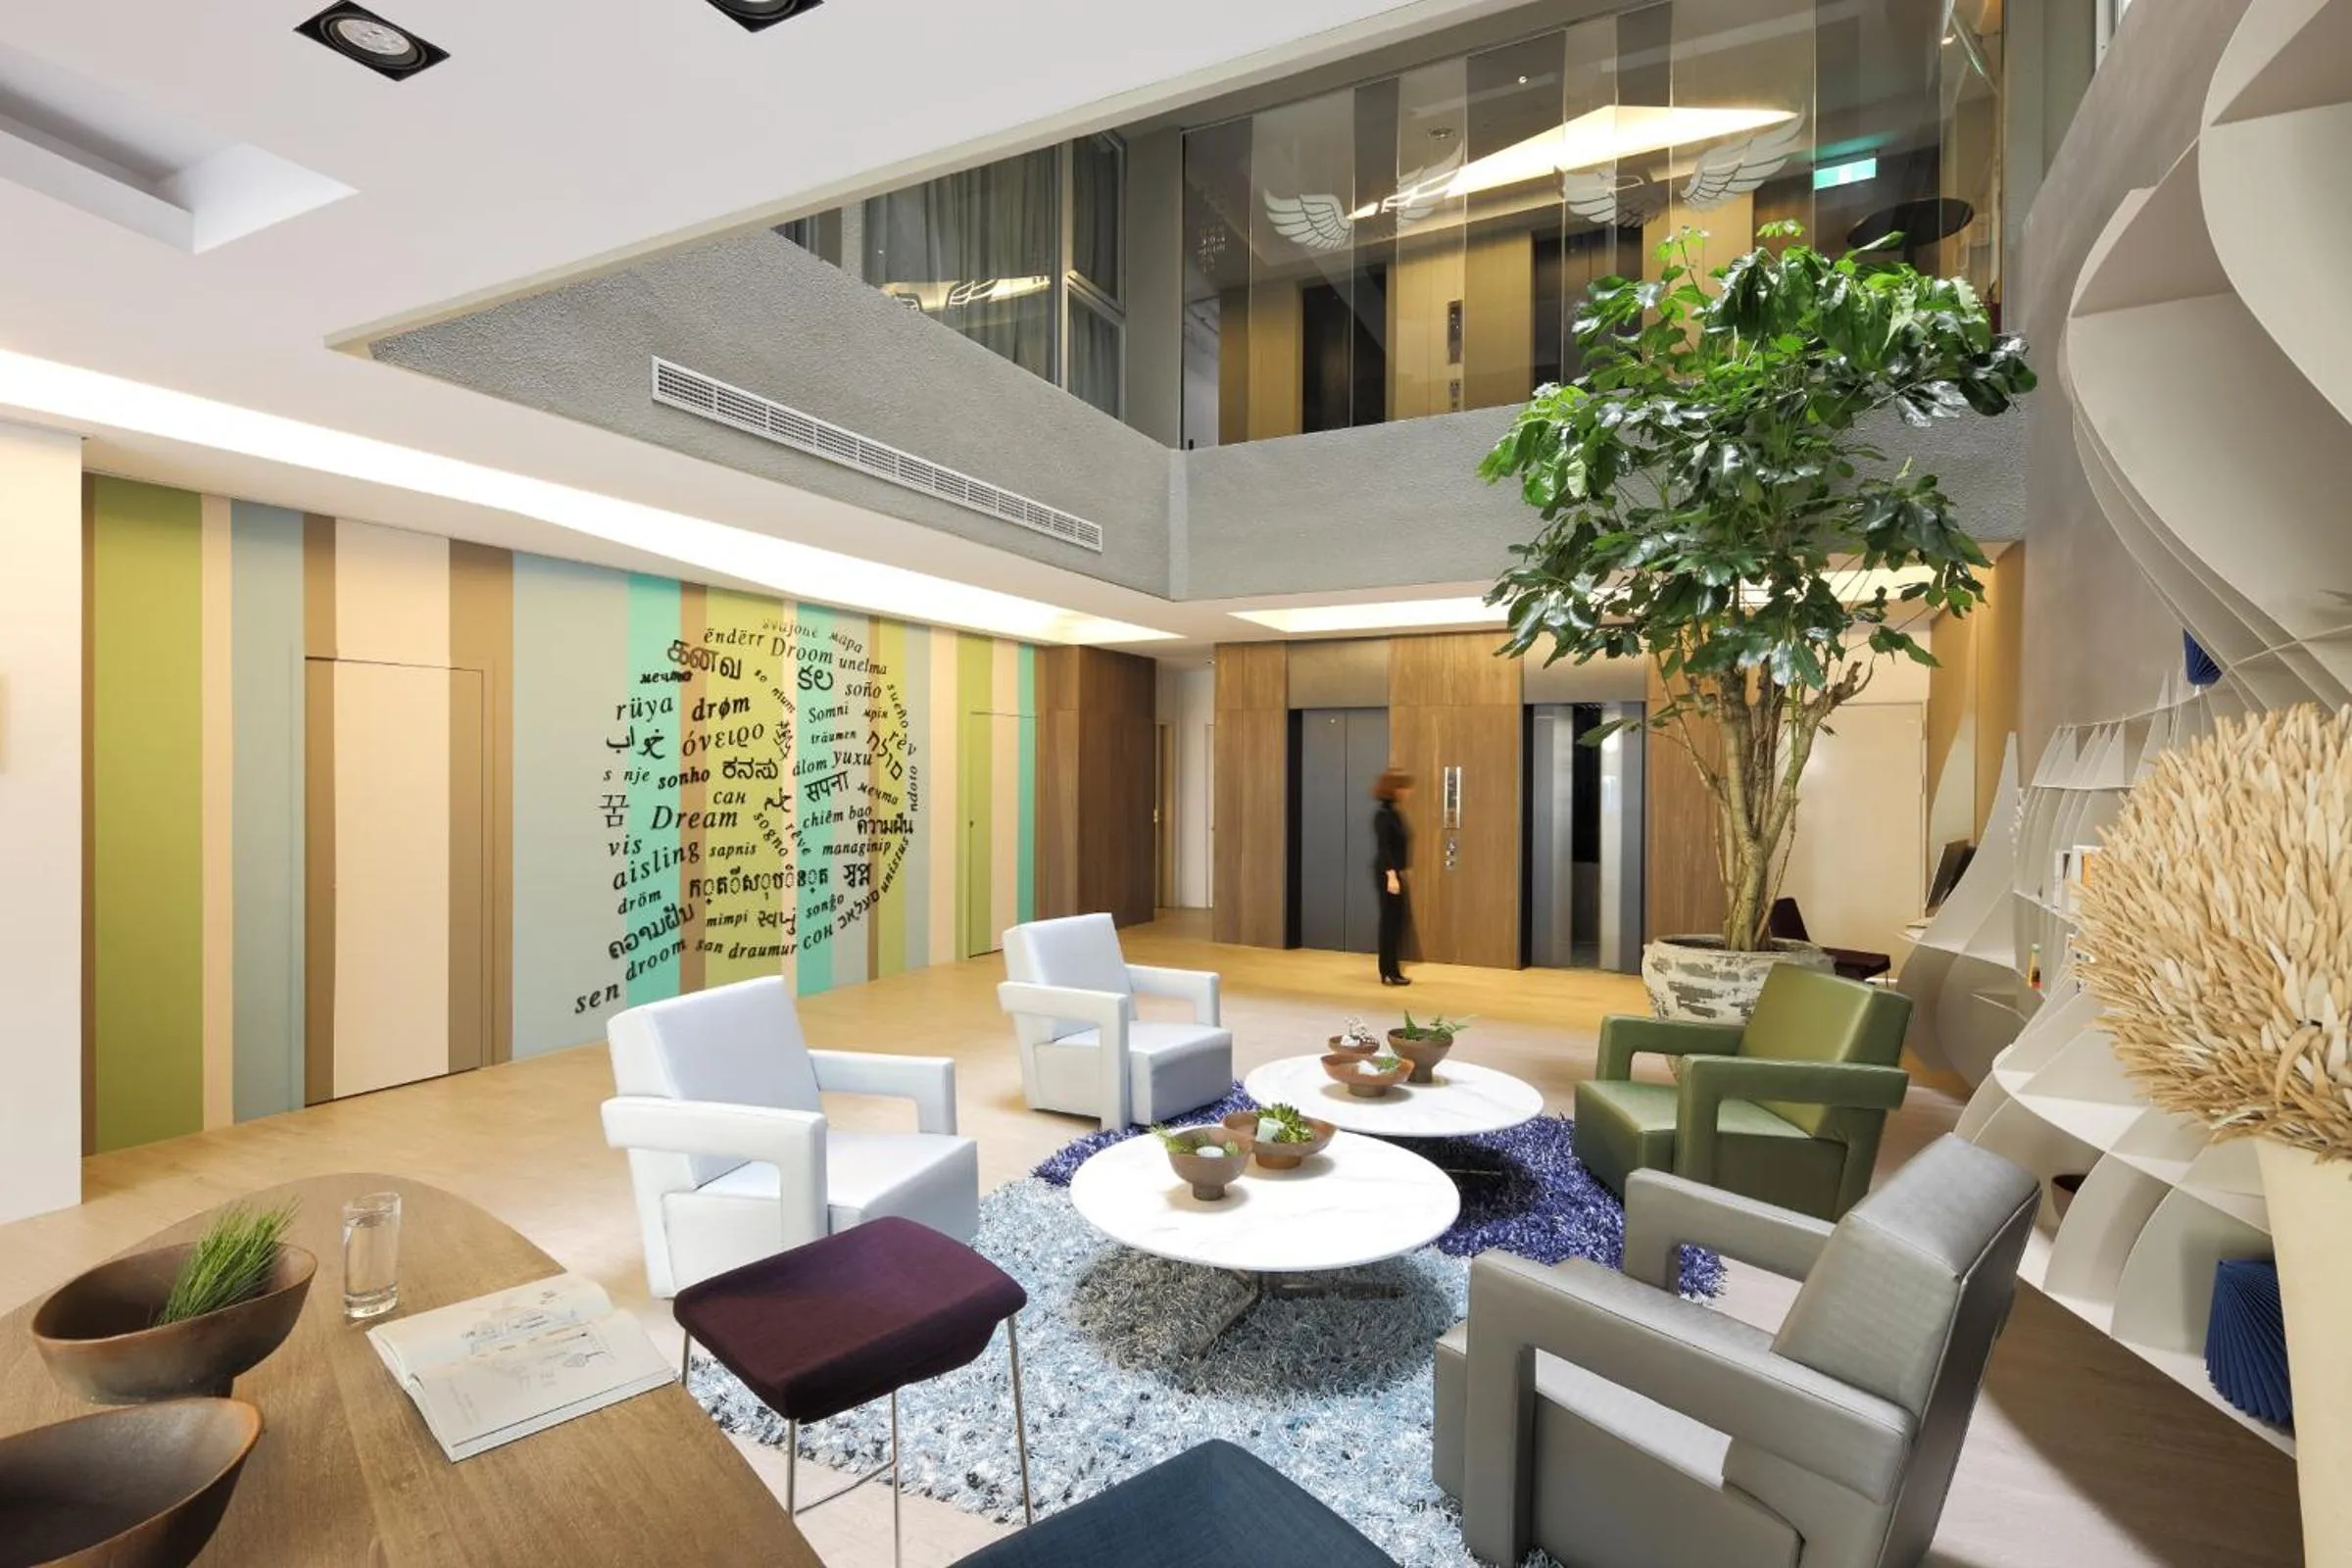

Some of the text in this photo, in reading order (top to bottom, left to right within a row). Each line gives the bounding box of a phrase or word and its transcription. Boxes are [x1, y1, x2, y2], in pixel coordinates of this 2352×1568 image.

[704, 627, 765, 647] ëndërr
[770, 637, 833, 664] Droom
[839, 658, 888, 675] unelma
[845, 682, 882, 699] soño
[615, 697, 673, 722] rüya
[691, 697, 751, 721] drøm
[808, 702, 849, 723] Somni
[832, 751, 872, 769] yuxu
[658, 766, 710, 789] sonho
[804, 770, 850, 803] सपना
[599, 794, 630, 828] 꿈
[651, 806, 738, 830] Dream
[849, 805, 872, 820] bao
[609, 834, 642, 857] vis
[710, 842, 757, 859] sapnis
[612, 841, 701, 890] aisling
[617, 890, 662, 914] dröm
[706, 909, 749, 927] mimpi
[695, 939, 723, 954] san
[728, 942, 798, 959] draumur
[625, 938, 687, 981] droom
[574, 984, 620, 1014] sen
